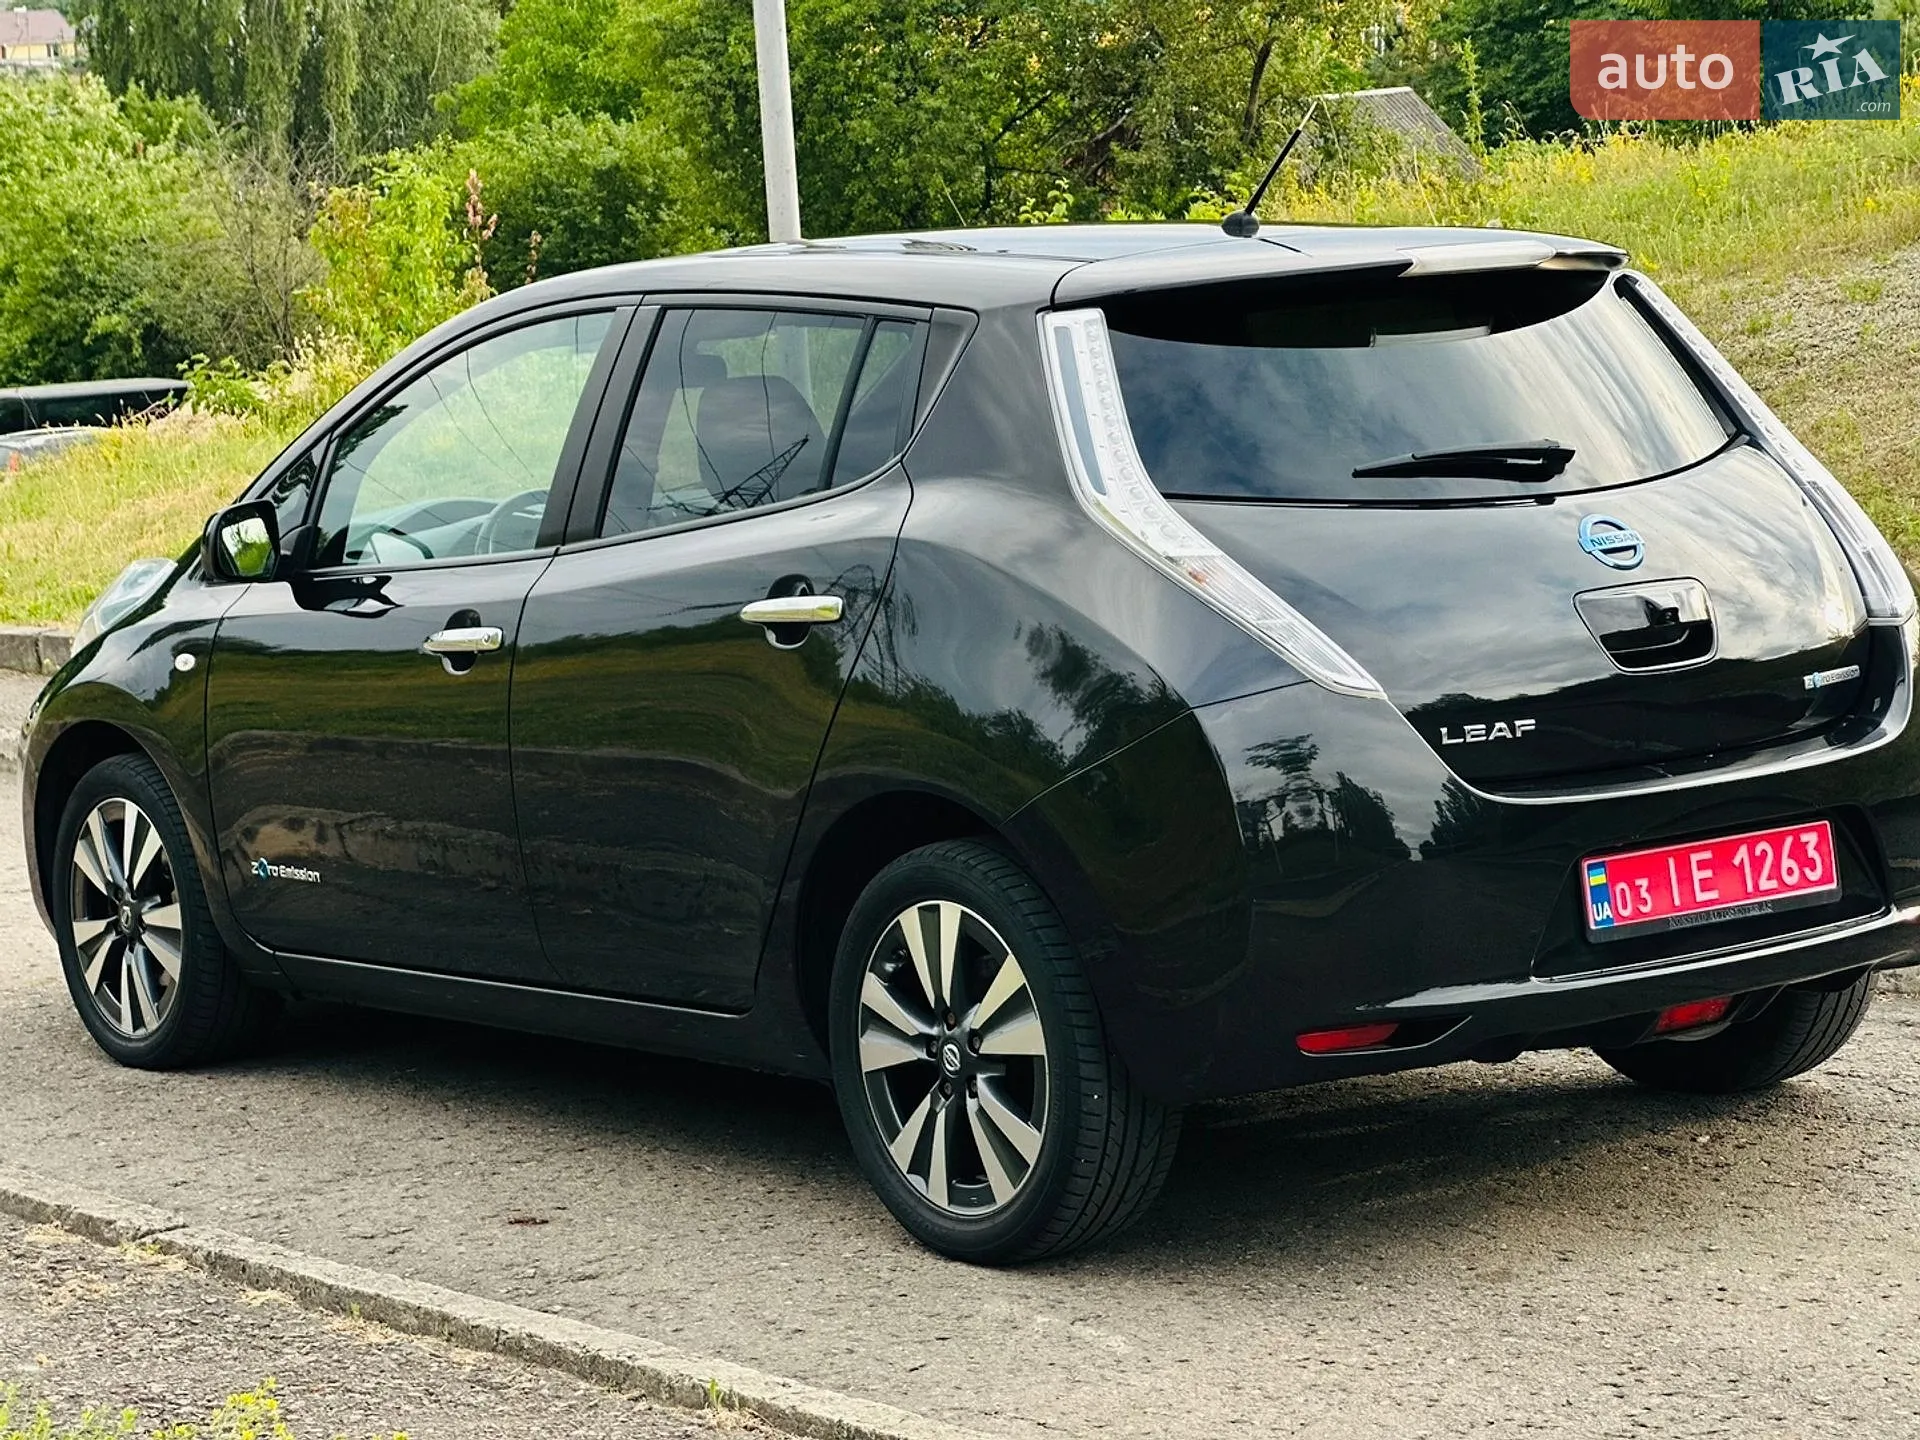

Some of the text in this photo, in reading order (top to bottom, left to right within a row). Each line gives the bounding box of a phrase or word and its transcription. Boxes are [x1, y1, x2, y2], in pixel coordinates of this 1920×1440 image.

[1590, 532, 1639, 548] NISSAN
[1440, 719, 1536, 745] LEAF
[279, 865, 321, 883] Emission
[1615, 877, 1653, 917] 03
[1667, 850, 1720, 907] IE
[1732, 831, 1822, 895] 1263
[1593, 901, 1613, 921] UA
